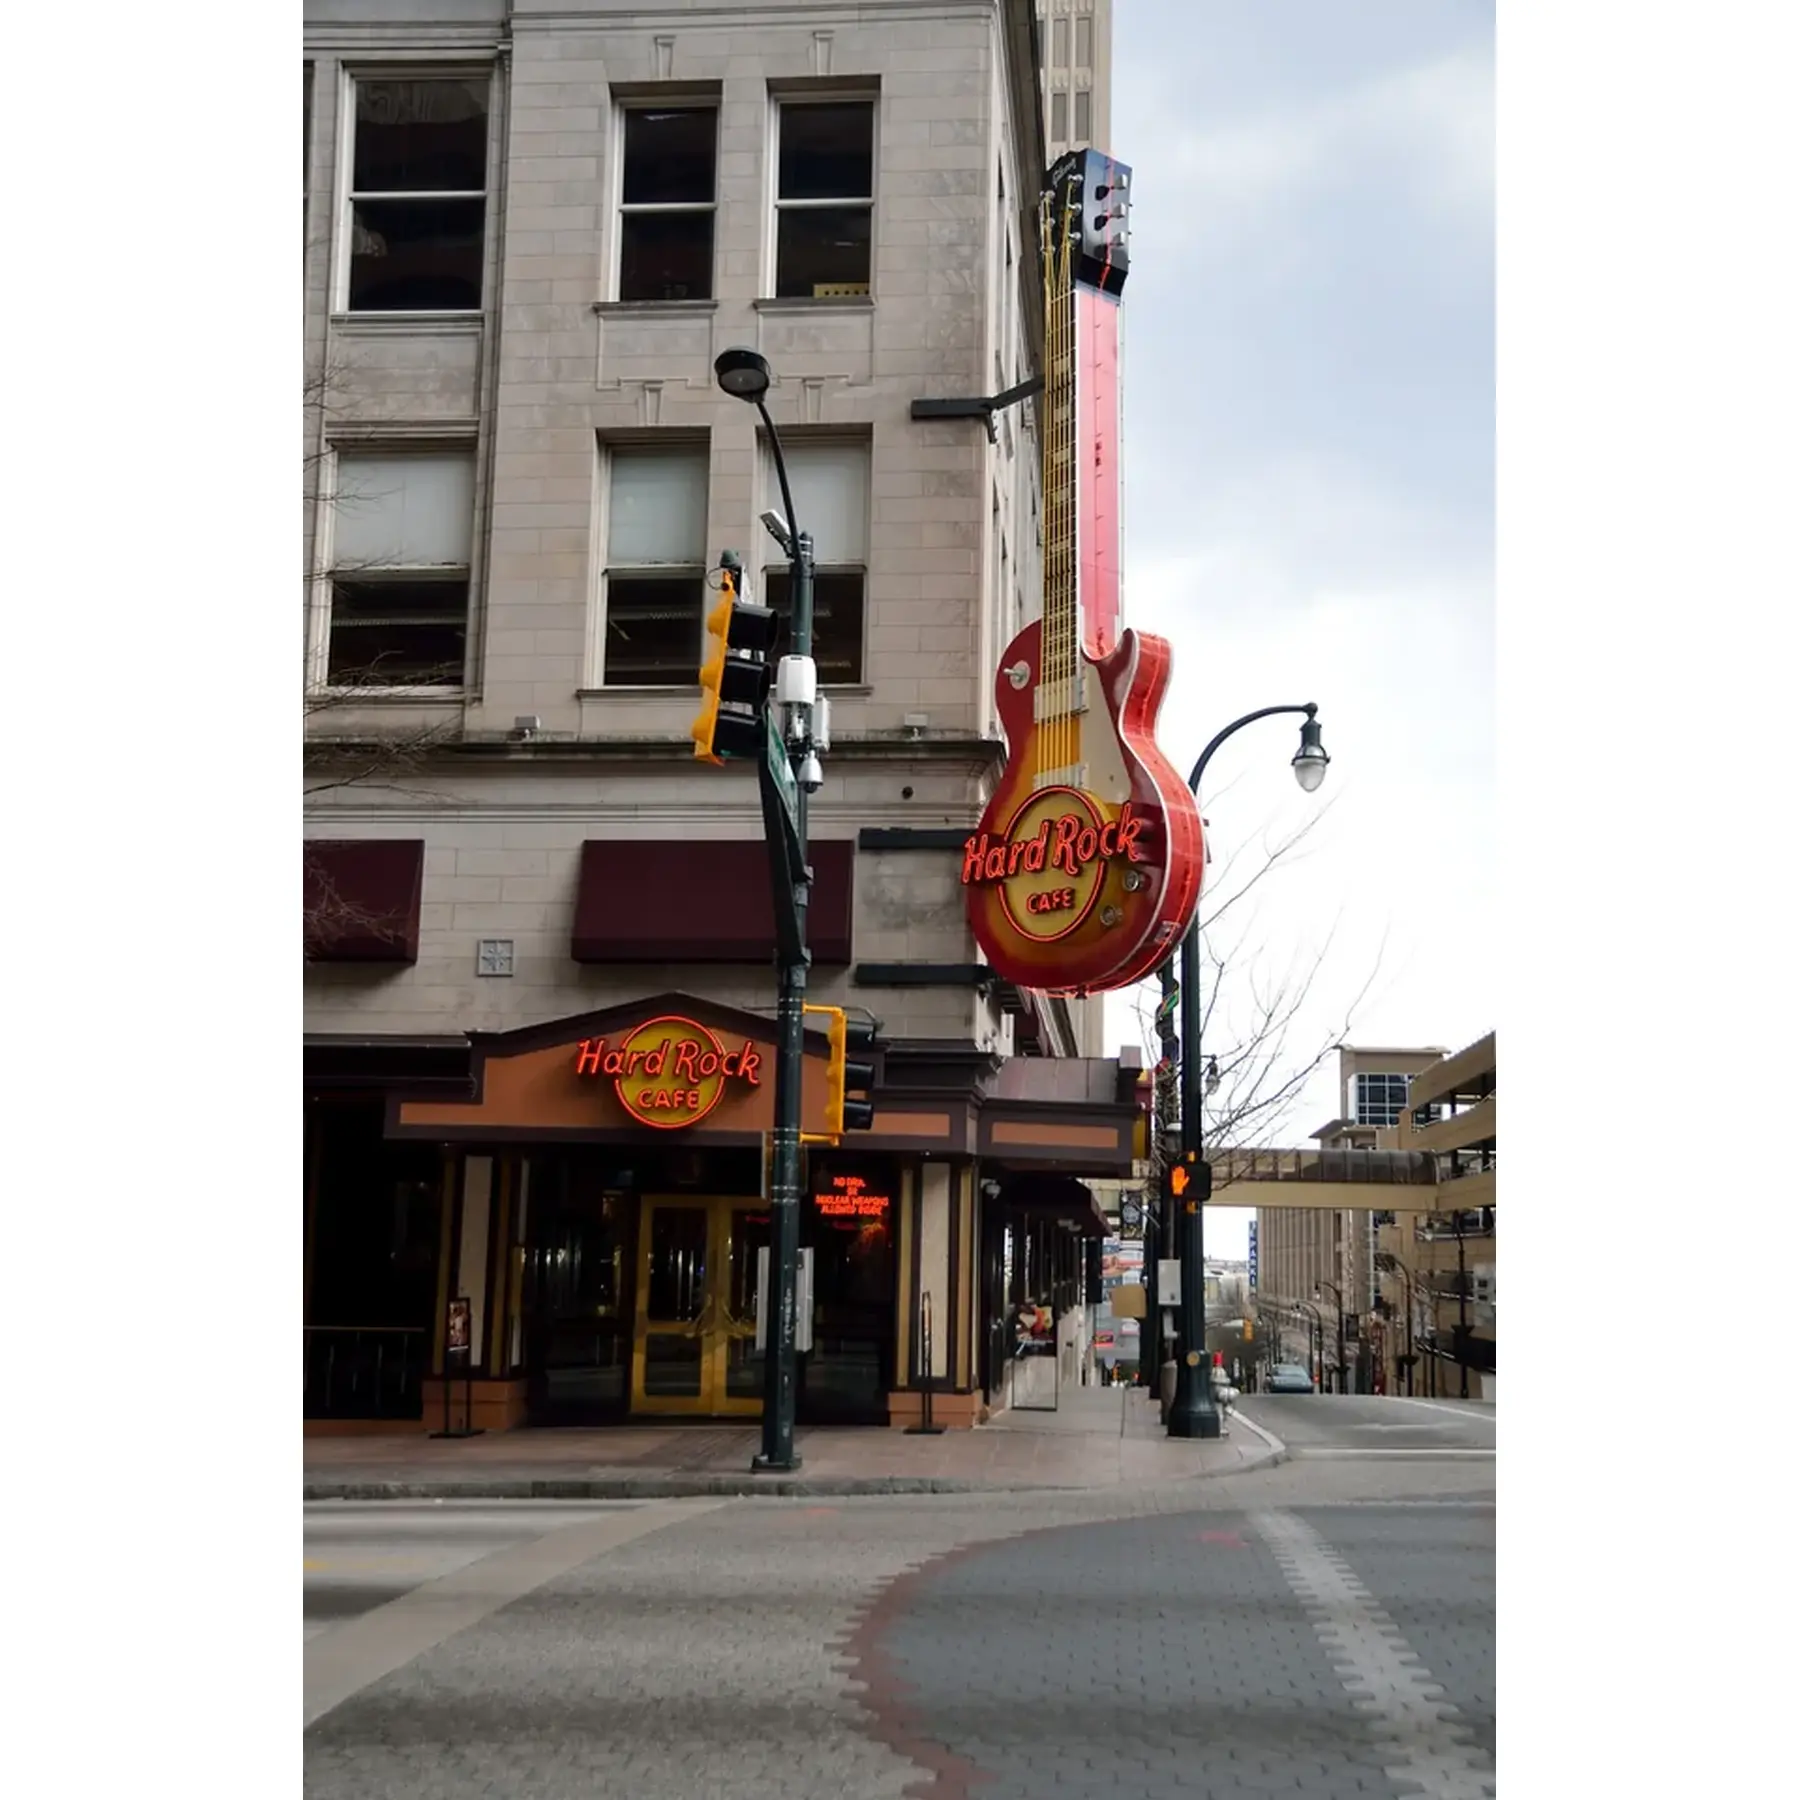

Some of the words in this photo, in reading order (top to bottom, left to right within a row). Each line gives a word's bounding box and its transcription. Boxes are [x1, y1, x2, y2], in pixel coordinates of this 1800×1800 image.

[962, 820, 1050, 883] Hard
[1053, 802, 1142, 875] Rock
[1027, 887, 1075, 914] CAFE
[576, 1038, 671, 1076] Hard
[674, 1038, 762, 1085] Rock
[638, 1089, 701, 1109] CAFE
